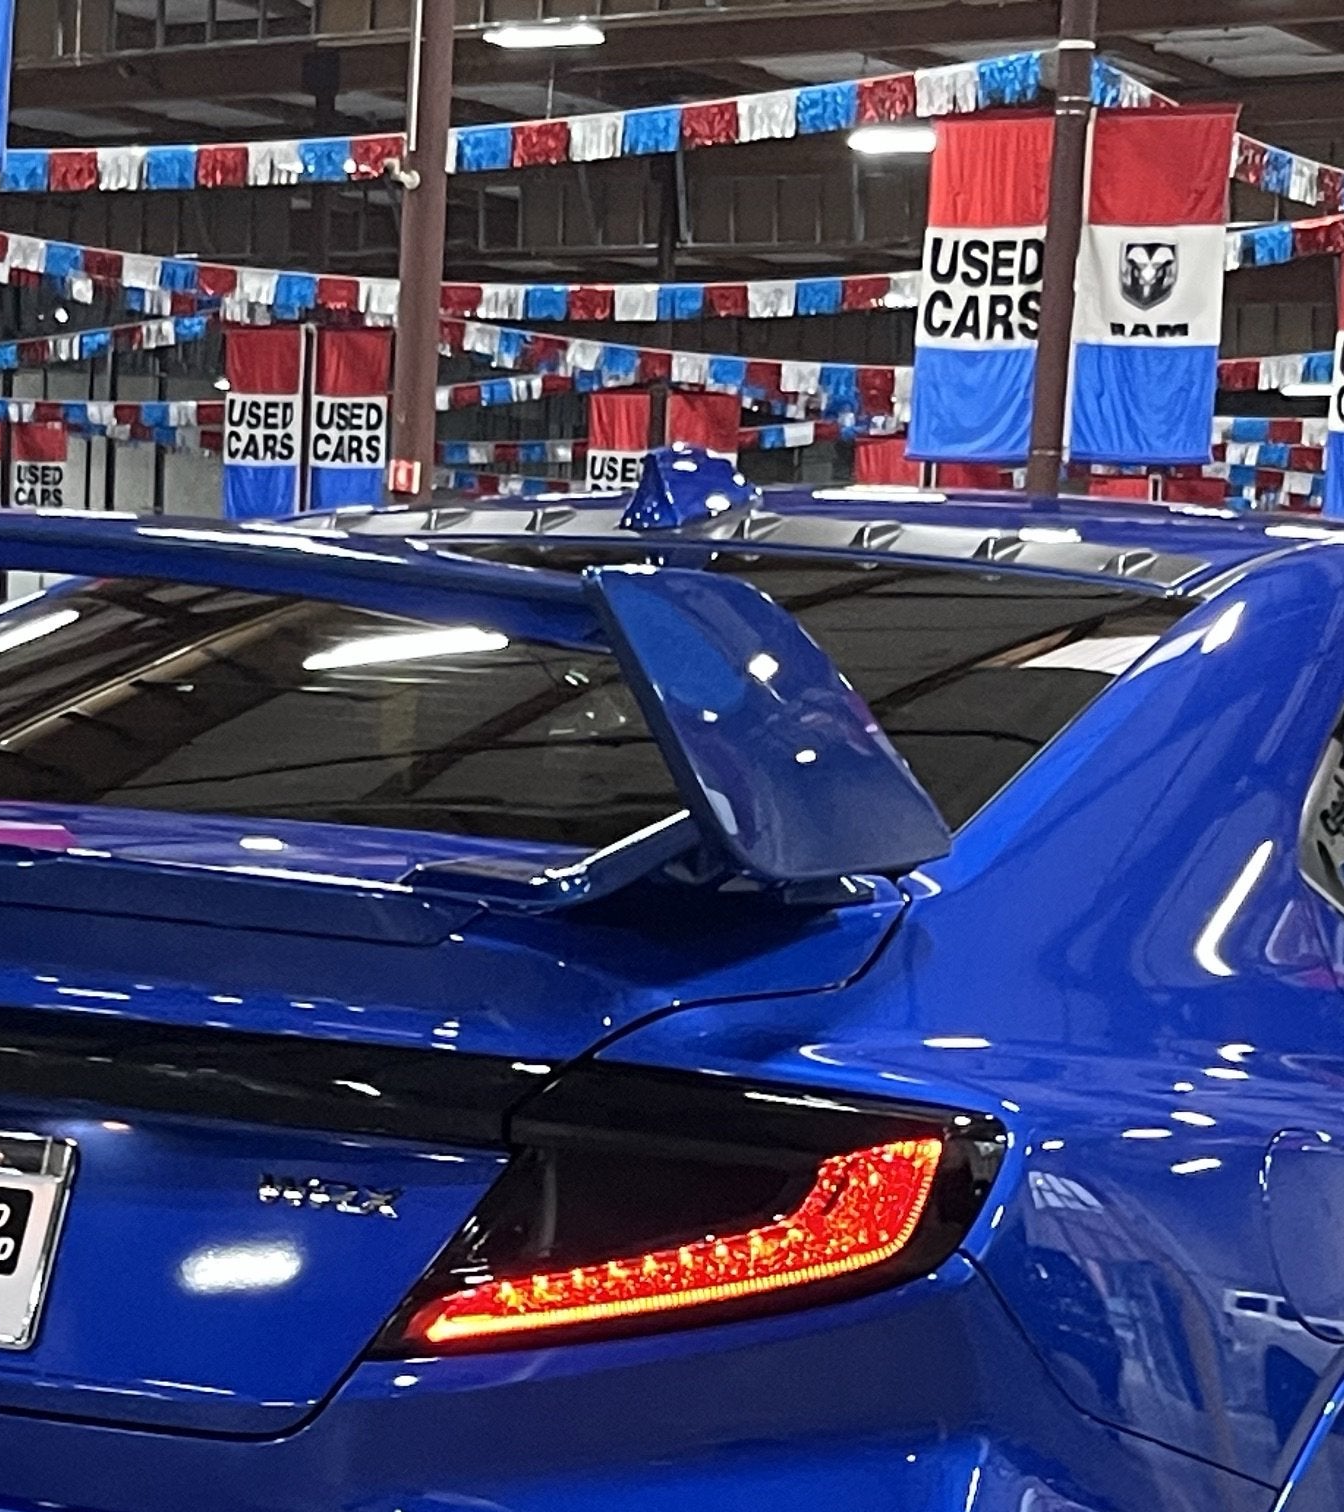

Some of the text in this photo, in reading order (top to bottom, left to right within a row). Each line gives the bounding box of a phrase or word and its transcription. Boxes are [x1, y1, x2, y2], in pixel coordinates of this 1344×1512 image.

[929, 237, 1044, 287] USED
[923, 290, 1040, 341] CARS
[228, 399, 294, 429] USED
[315, 401, 383, 431] USED
[227, 430, 295, 460] CARS
[312, 433, 381, 464] CARS
[16, 465, 64, 486] USED
[590, 455, 644, 483] USE
